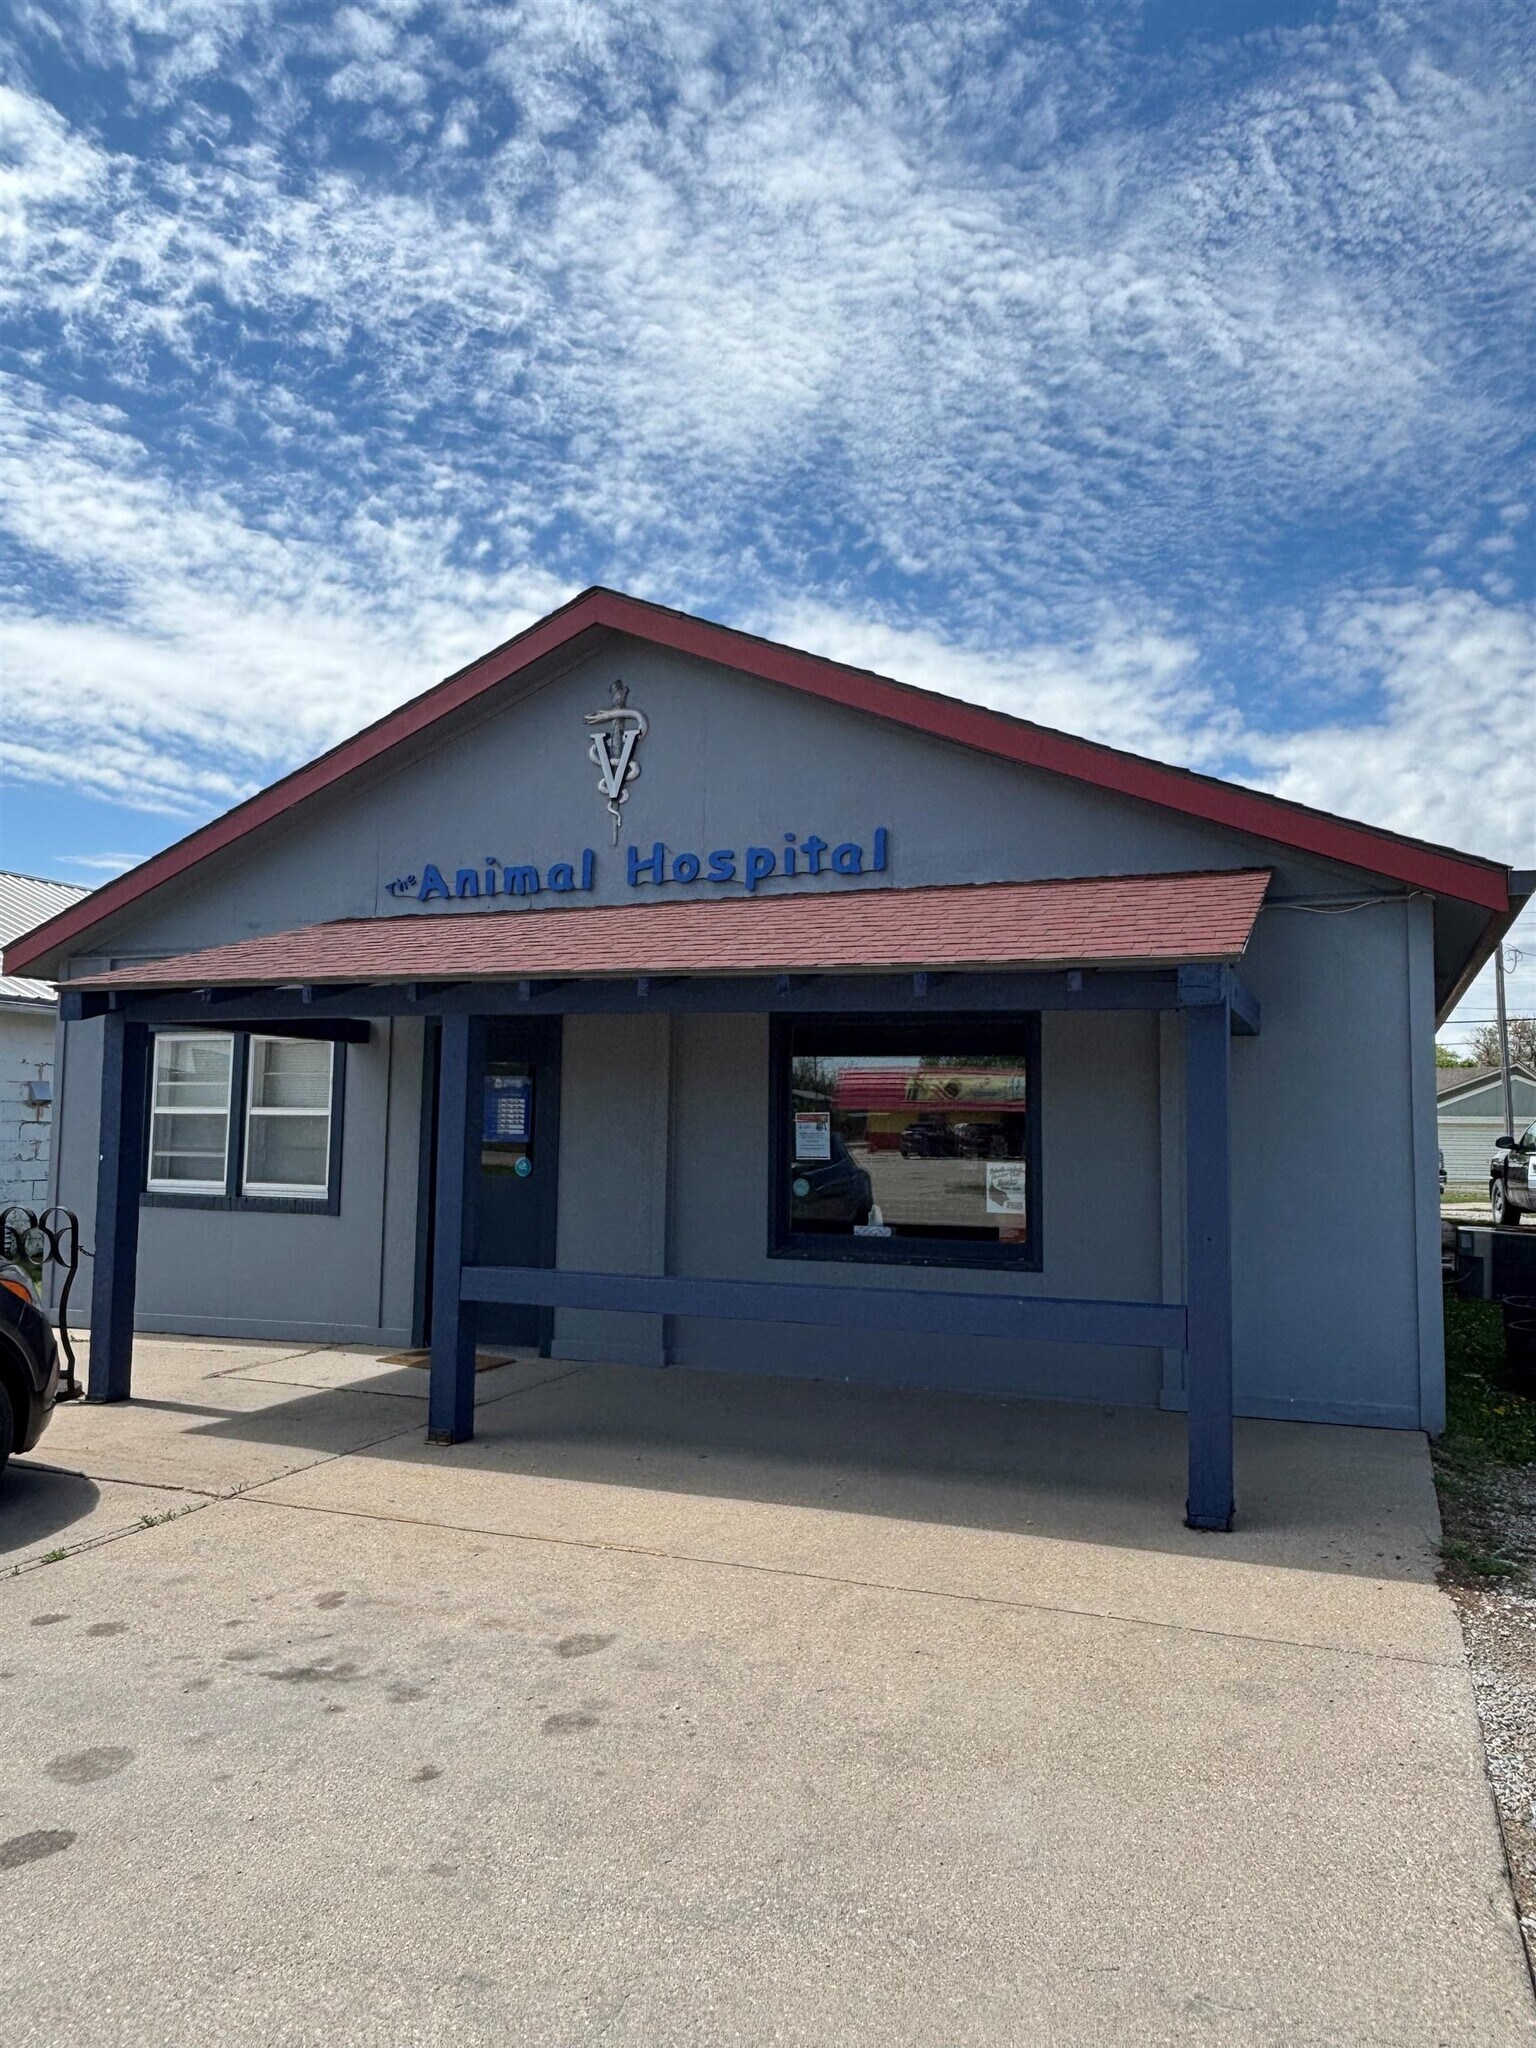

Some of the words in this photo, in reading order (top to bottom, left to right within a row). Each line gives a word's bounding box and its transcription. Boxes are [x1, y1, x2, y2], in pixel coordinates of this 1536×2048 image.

[590, 729, 641, 799] V
[417, 848, 594, 900] Animal
[627, 827, 888, 891] Hospital
